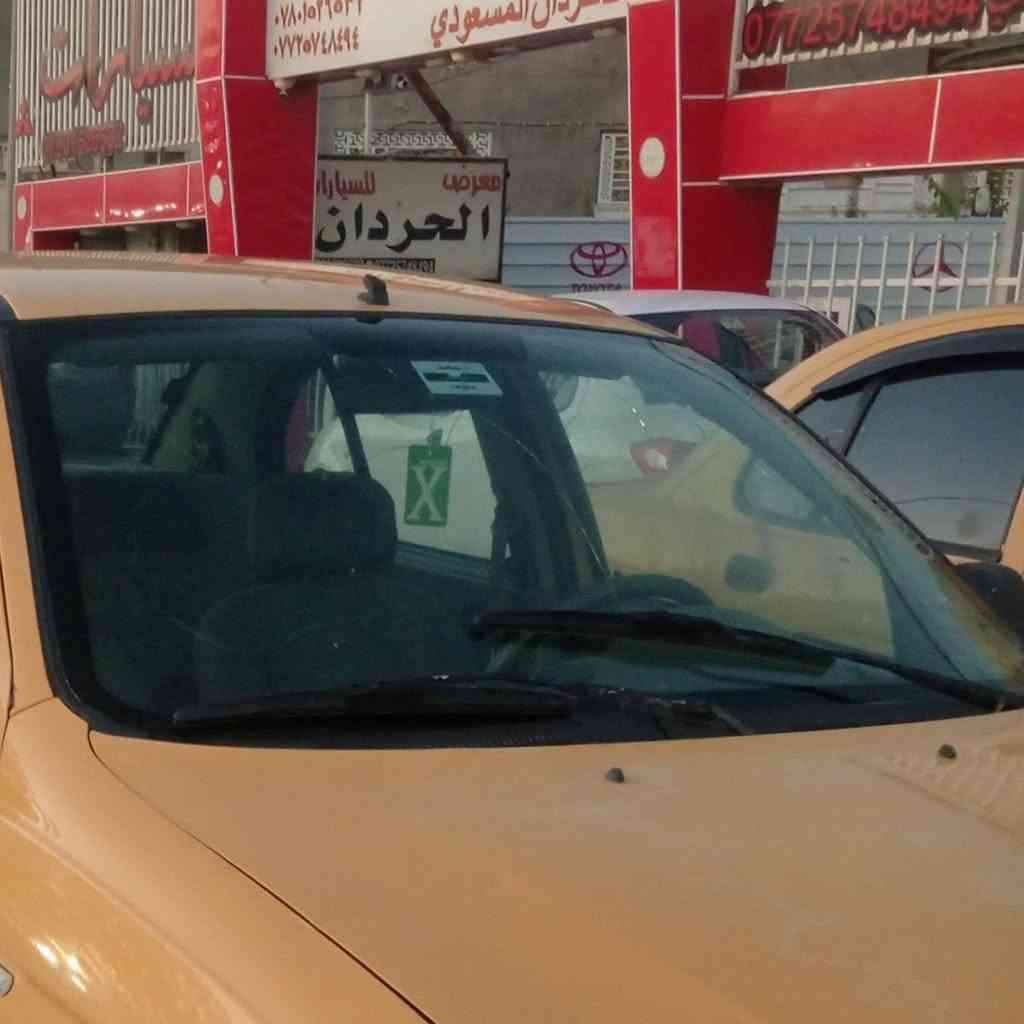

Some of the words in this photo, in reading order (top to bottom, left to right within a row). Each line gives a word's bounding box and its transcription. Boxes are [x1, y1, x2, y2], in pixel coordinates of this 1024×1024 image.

[317, 169, 375, 200] للسيارا
[442, 173, 501, 197] معرض
[316, 202, 490, 253] الحردان
